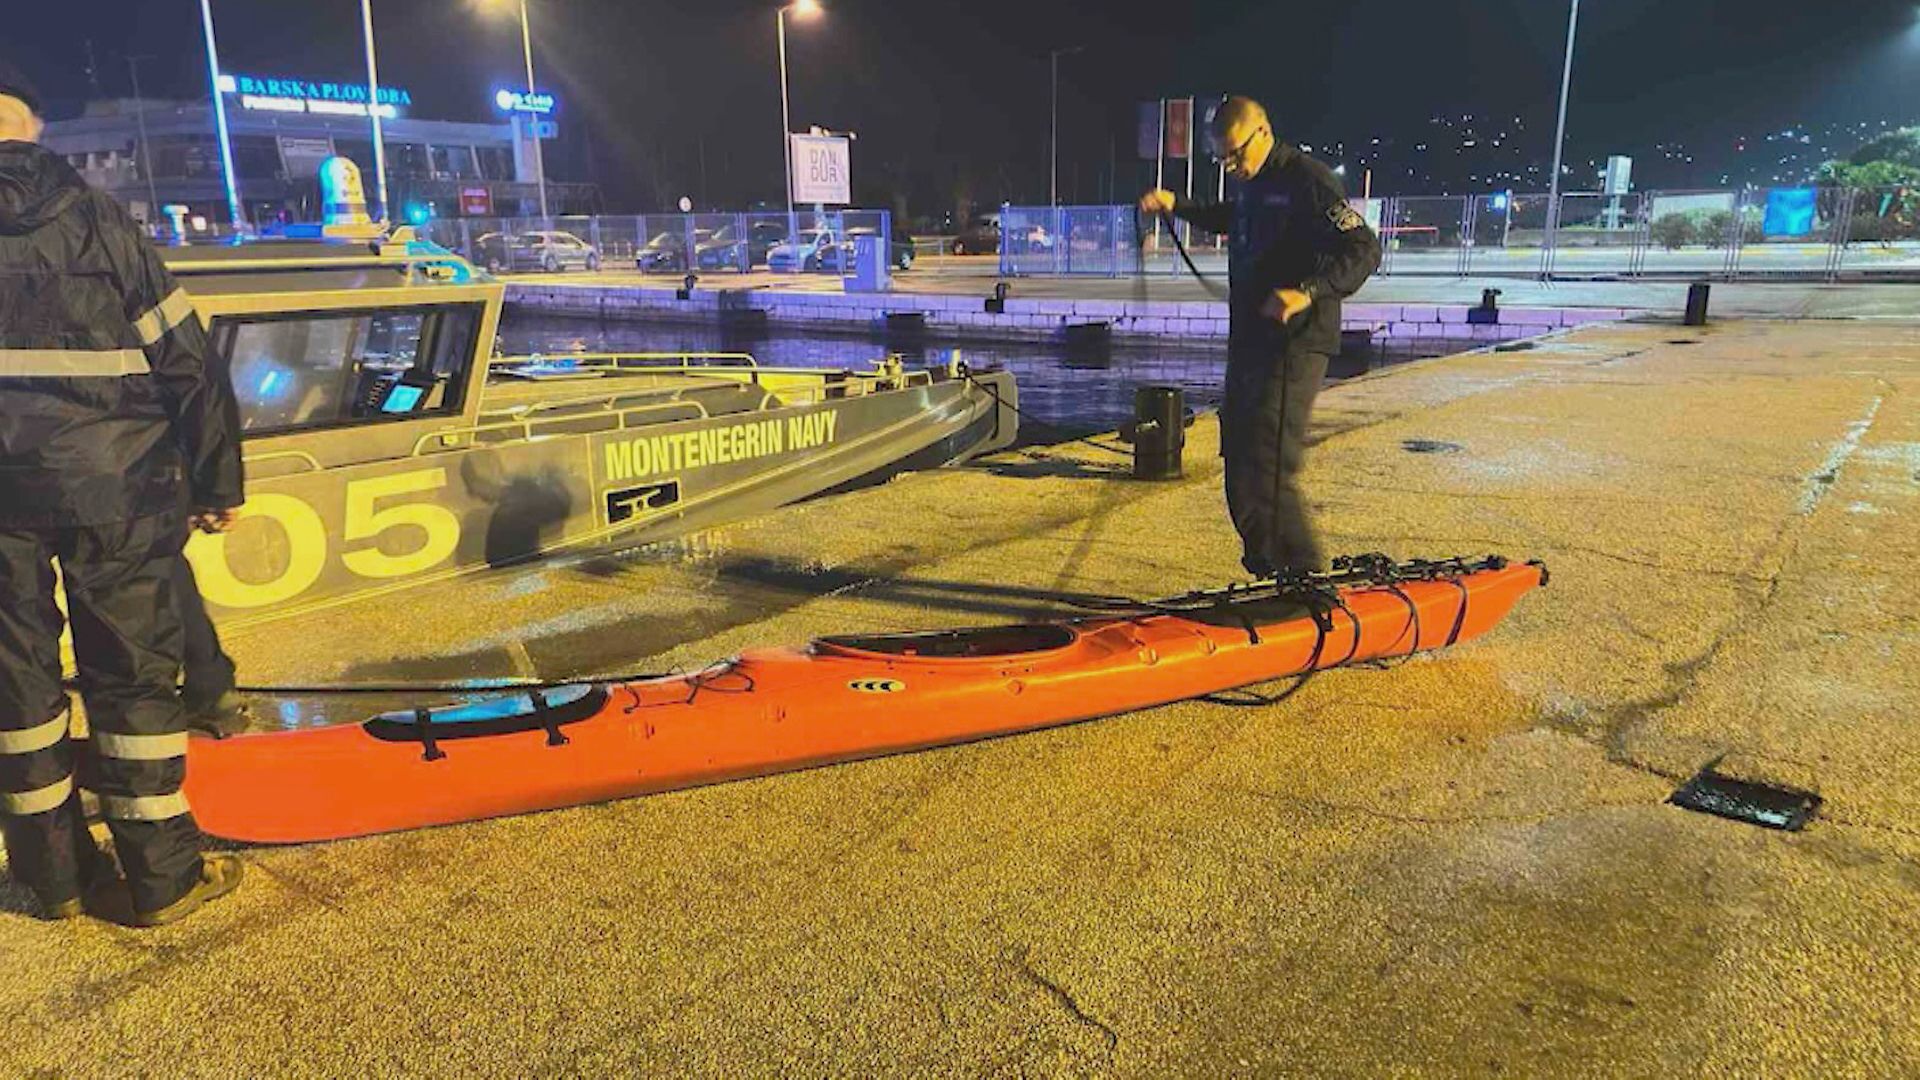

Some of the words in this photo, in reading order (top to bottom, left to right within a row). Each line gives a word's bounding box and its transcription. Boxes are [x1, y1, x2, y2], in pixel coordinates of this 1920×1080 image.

[240, 77, 320, 98] BARSKA
[322, 83, 411, 105] PLOVDBA
[605, 419, 783, 480] MONTENEGRIN
[788, 409, 837, 451] NAVY
